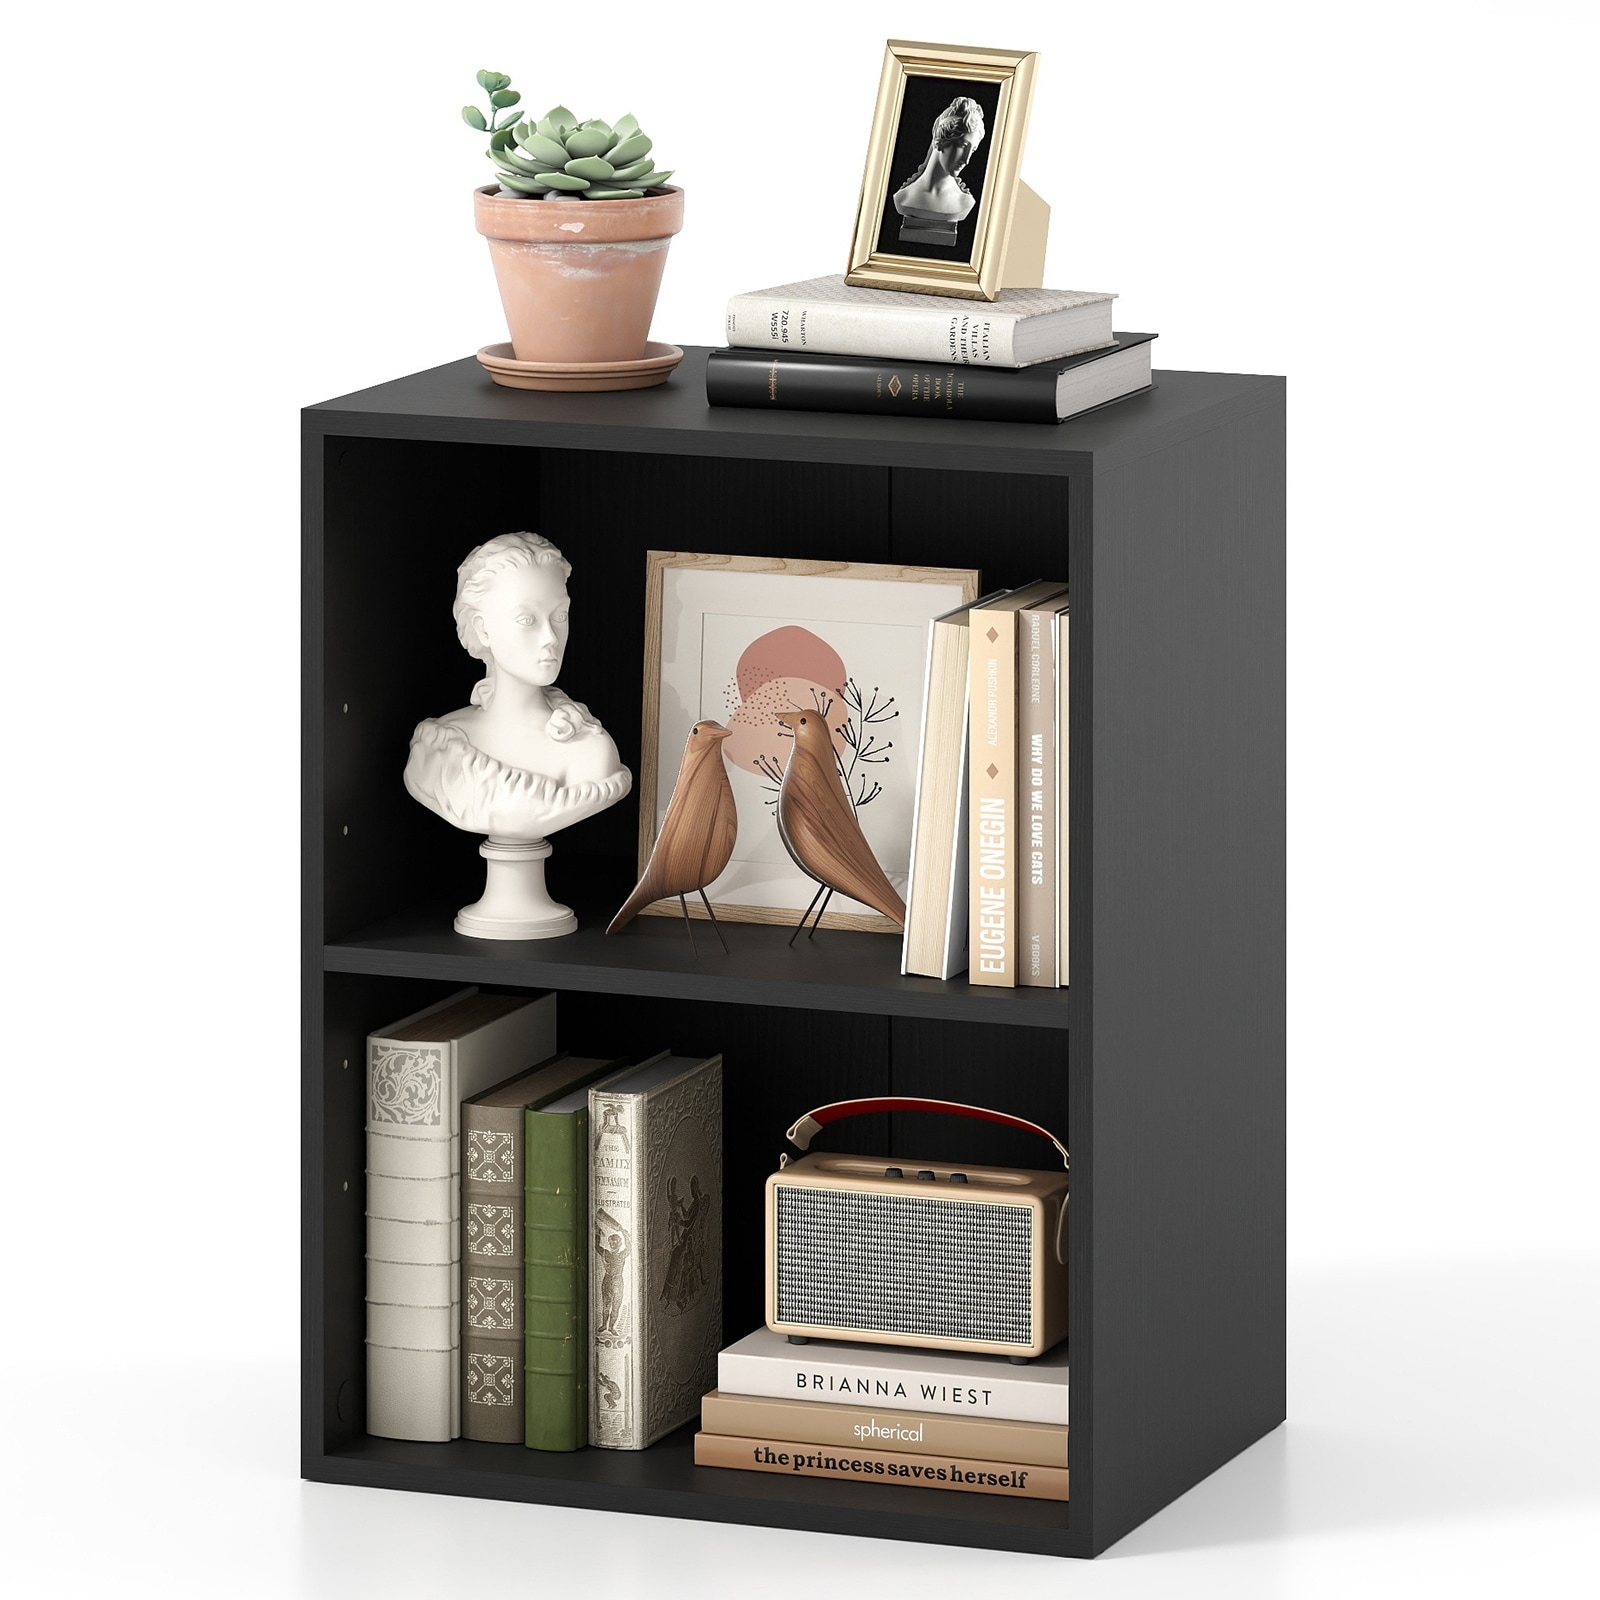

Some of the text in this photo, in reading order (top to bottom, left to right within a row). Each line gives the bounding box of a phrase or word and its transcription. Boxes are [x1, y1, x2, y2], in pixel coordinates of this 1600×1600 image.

[781, 310, 789, 343] 720.945
[800, 310, 808, 346] WHARTON
[949, 317, 958, 361] GARDENS
[960, 315, 970, 365] AND THEIR
[971, 324, 980, 358] VILLAS
[982, 322, 991, 361] ITALIAN
[923, 374, 931, 402] OF THE
[1031, 614, 1040, 704] RAQUEL CORLEONE
[987, 658, 998, 746] ALEXANDR PUSHKIN
[1031, 733, 1043, 886] WHY DO WE LOVE CATS
[979, 797, 1006, 974] EUGENE ONEGIN
[603, 1144, 619, 1152] THE
[796, 1372, 993, 1406] BRIANNA WIEST
[853, 1419, 923, 1443] spherical
[753, 1446, 1029, 1489] the princess saves herself
